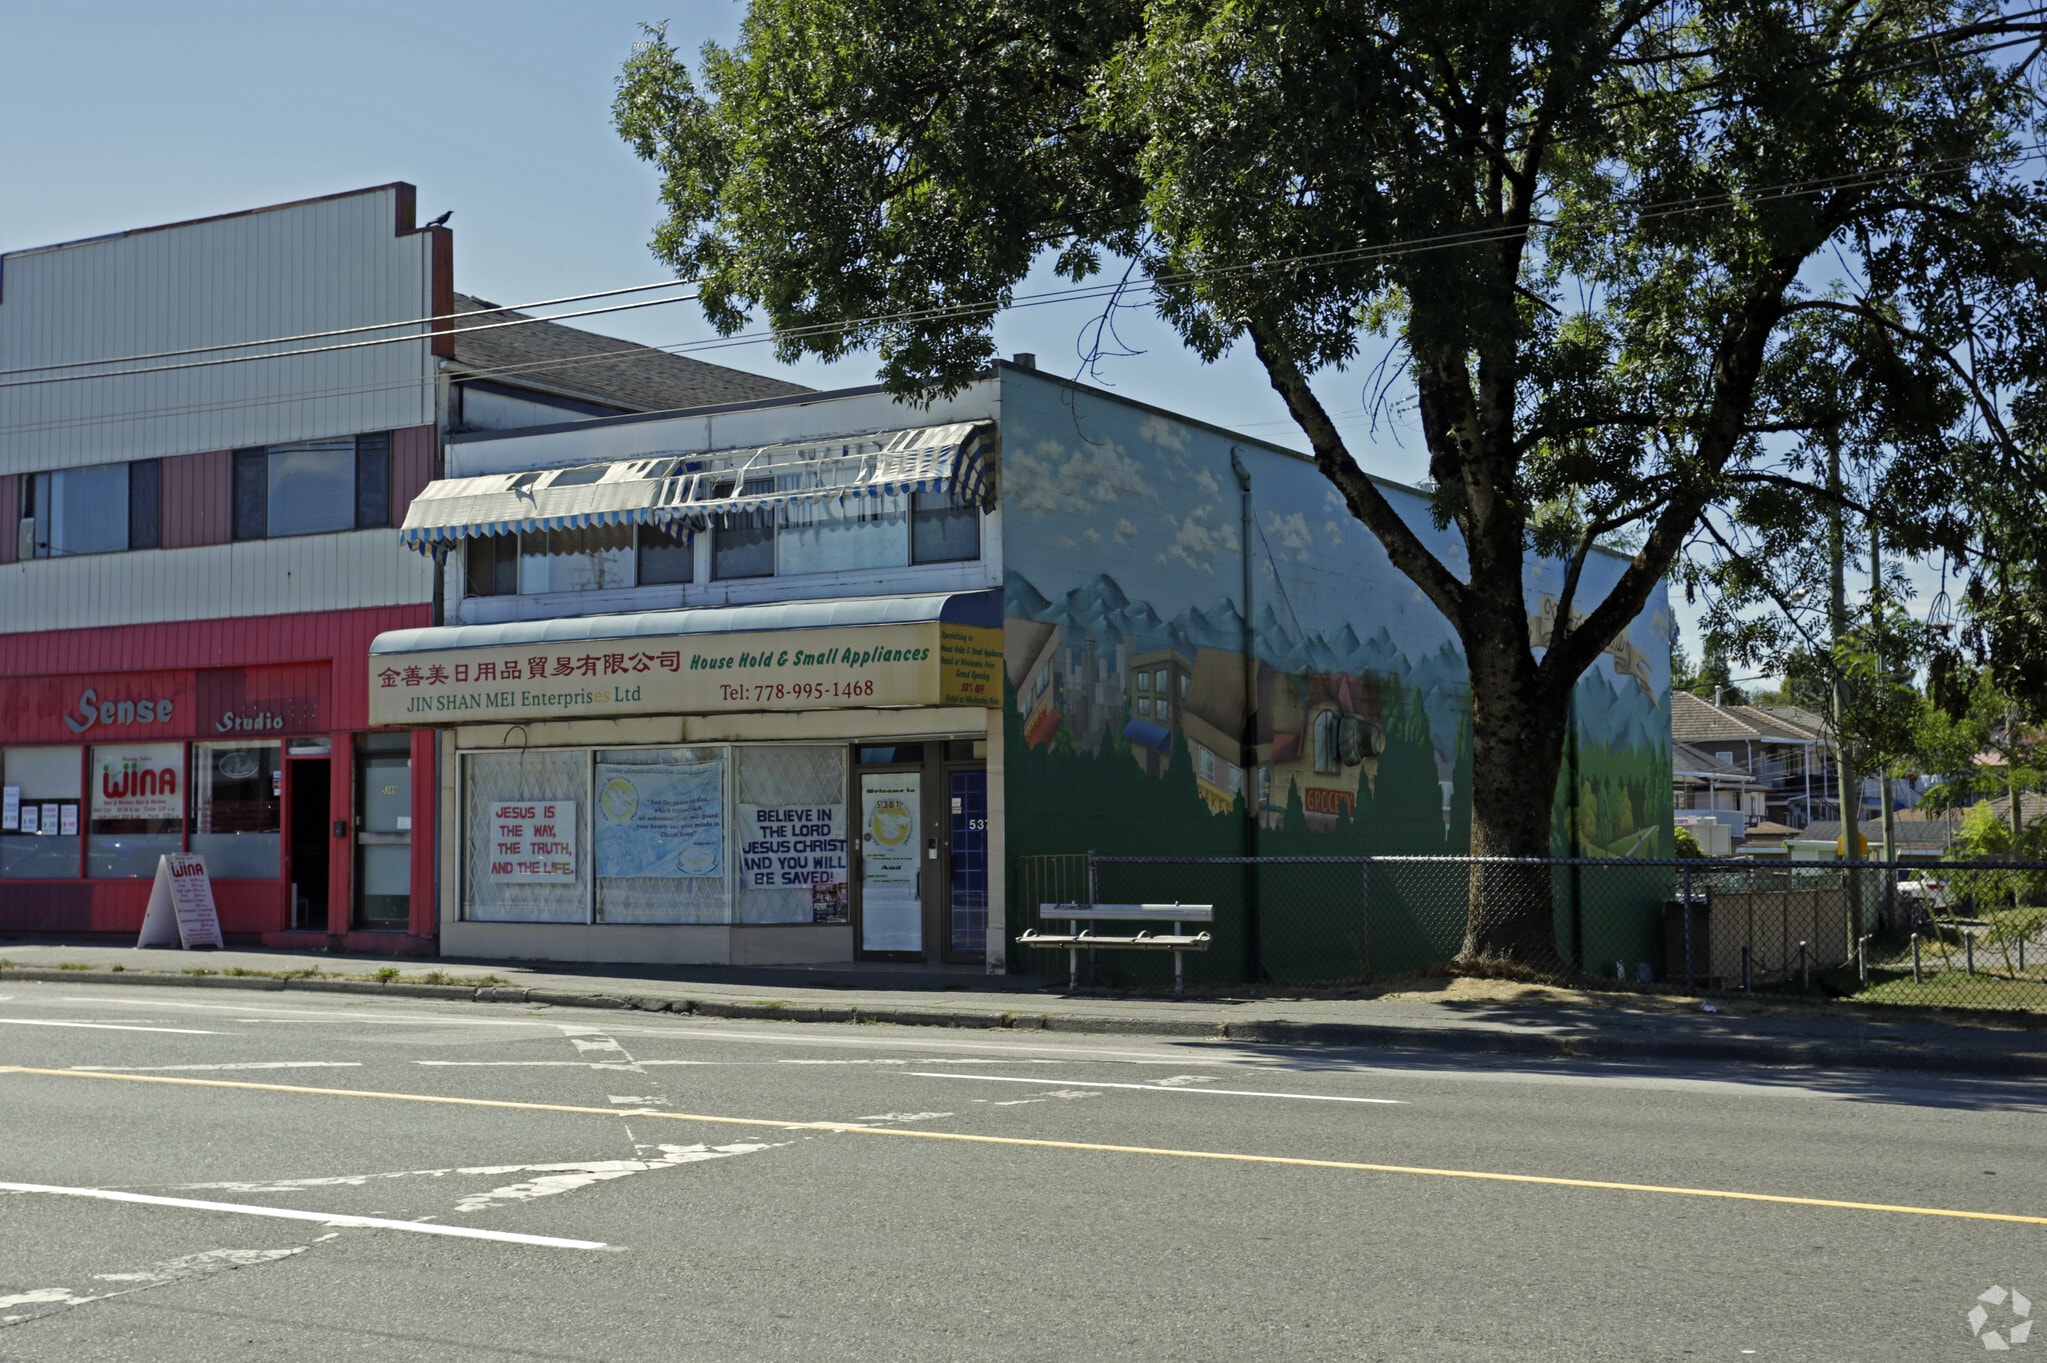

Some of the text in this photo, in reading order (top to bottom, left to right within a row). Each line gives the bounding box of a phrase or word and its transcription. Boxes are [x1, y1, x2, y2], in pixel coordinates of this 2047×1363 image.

[690, 645, 930, 670] House Hold & Small Appliances
[377, 650, 681, 688] 金善美日用品貿易有限公司
[720, 679, 874, 702] Tel: 778-995-1468
[407, 685, 641, 713] JIN SHAN MEI Enterprises Ltd
[64, 688, 173, 733] Sense
[216, 711, 284, 732] Studio
[876, 800, 899, 809] 5381
[496, 806, 555, 819] JESUS IS
[757, 809, 832, 822] BELIEVE IN
[499, 825, 556, 838] THE WAY,
[760, 824, 831, 839] THE LORD
[498, 842, 572, 856] THE TRUTH,
[743, 839, 847, 855] JESUS CHRIST
[491, 861, 574, 875] AND THE LIFE.
[744, 856, 846, 871] AND YOU WILL
[754, 871, 834, 885] BE SAVED!
